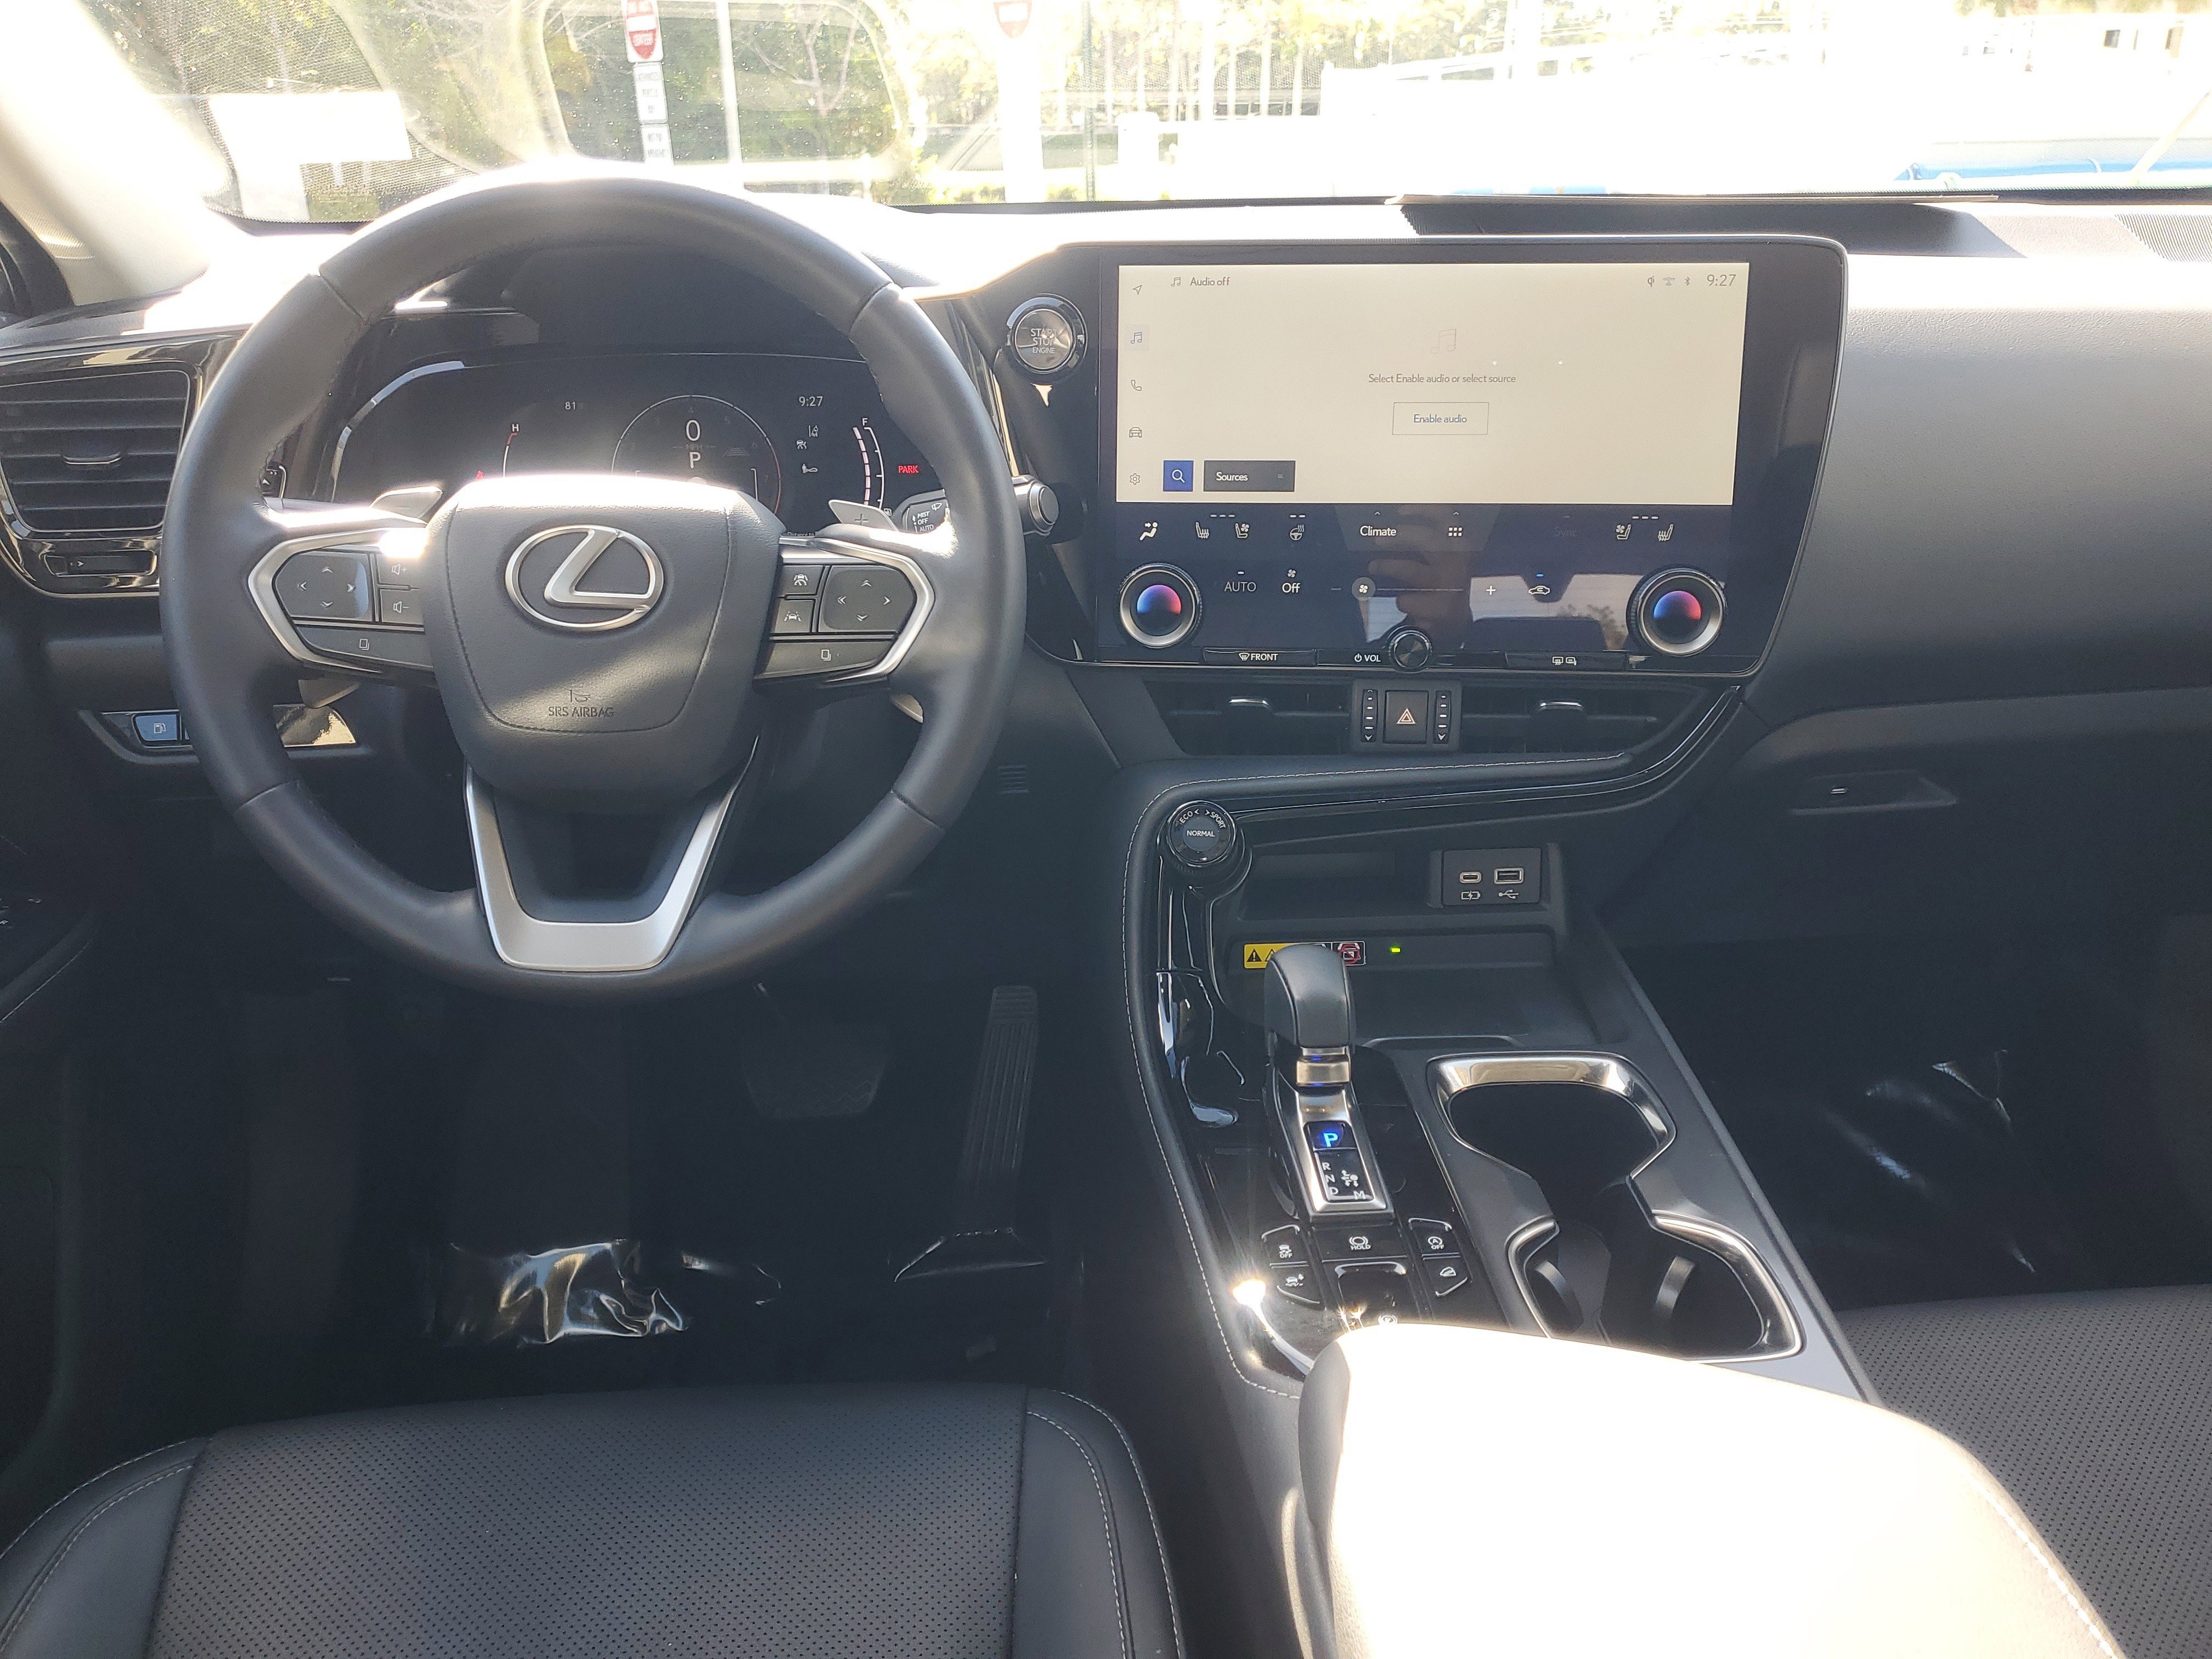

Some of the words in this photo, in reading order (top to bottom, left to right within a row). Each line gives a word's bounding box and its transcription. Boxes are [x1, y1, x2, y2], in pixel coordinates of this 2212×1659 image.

[1190, 276, 1215, 286] Audio
[1217, 276, 1231, 286] off
[1707, 274, 1736, 286] 9:27
[1368, 374, 1394, 383] Select
[1396, 374, 1424, 383] Enable
[1426, 374, 1450, 383] audio
[1463, 374, 1487, 383] select
[799, 396, 823, 407] 9:27
[862, 417, 868, 426] F
[1413, 414, 1442, 423] Enable
[1443, 414, 1468, 423] audio
[512, 423, 520, 432] H
[690, 452, 701, 469] P
[898, 465, 919, 473] PARK
[1216, 471, 1249, 481] Sources
[1360, 525, 1397, 536] Climate
[1223, 582, 1256, 592] AUTO
[1282, 582, 1301, 593] Off
[1250, 653, 1278, 661] FRONT
[548, 706, 569, 716] SRS
[572, 707, 614, 717] AIRBAG
[1180, 810, 1193, 823] ECO
[1210, 811, 1226, 828] SPORT
[1323, 1133, 1338, 1147] P
[1322, 1162, 1331, 1171] R
[1325, 1174, 1336, 1182] N
[1329, 1187, 1339, 1195] D
[1353, 1190, 1366, 1200] M
